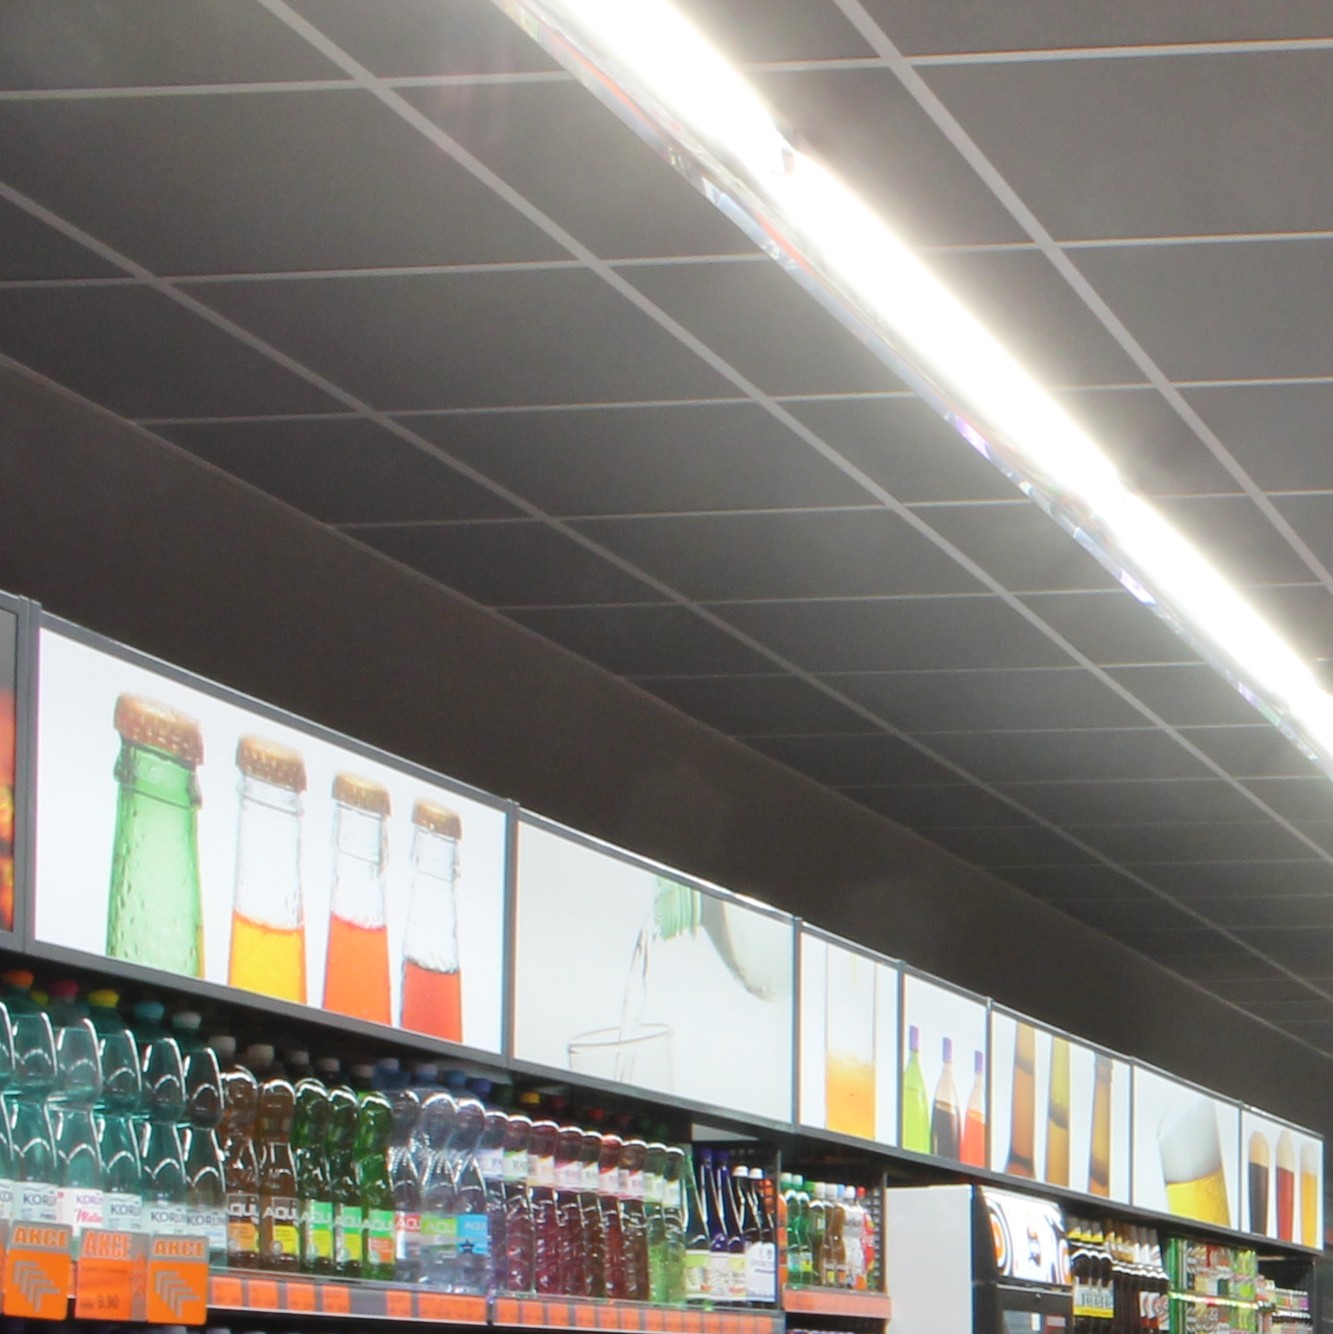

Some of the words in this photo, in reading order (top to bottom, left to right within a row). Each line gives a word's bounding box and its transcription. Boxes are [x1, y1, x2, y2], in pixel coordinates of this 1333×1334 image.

[14, 1226, 68, 1248] AKCE
[82, 1230, 131, 1259] AKCE
[155, 1238, 205, 1257] AKCE
